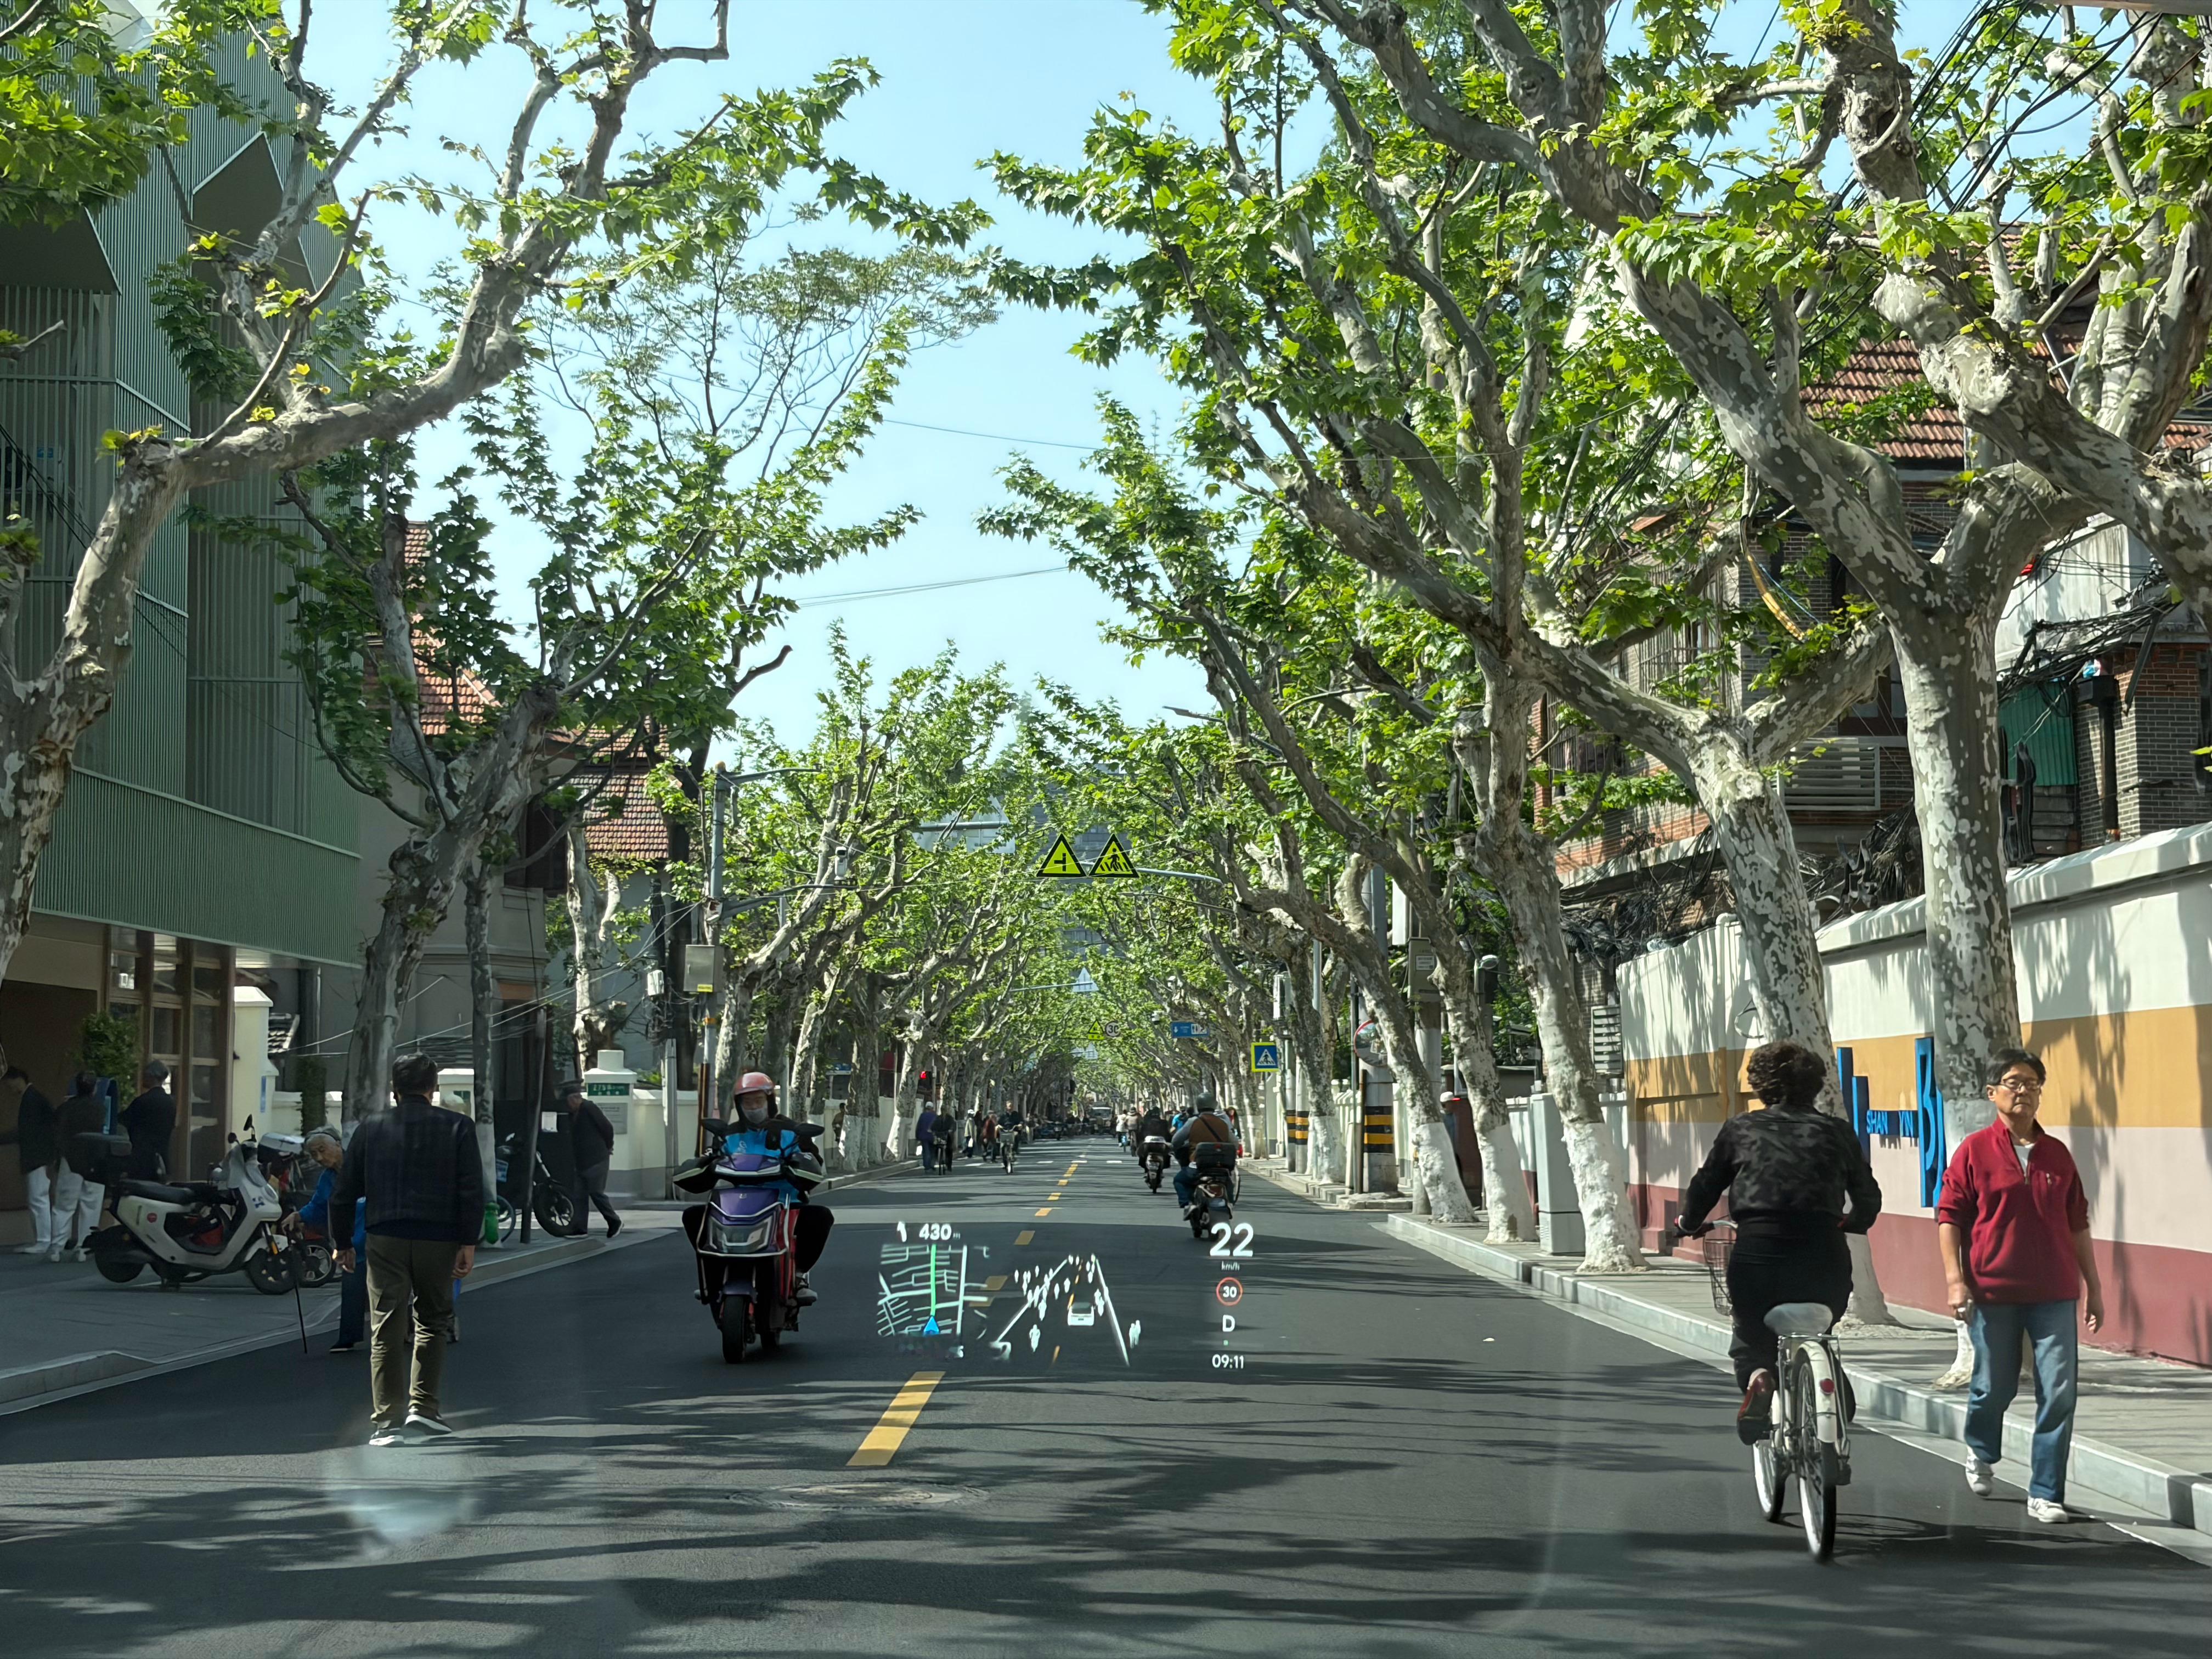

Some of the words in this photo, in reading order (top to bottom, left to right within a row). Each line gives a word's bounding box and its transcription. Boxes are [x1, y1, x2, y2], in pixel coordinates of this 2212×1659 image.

[1108, 1025, 1119, 1034] 30
[1866, 1110, 1888, 1135] SHAN
[919, 1223, 952, 1240] 430
[1210, 1222, 1254, 1257] 22
[1221, 1261, 1240, 1271] km/h
[1223, 1286, 1237, 1298] 30
[1222, 1315, 1235, 1332] D
[1212, 1354, 1244, 1369] 09:11
